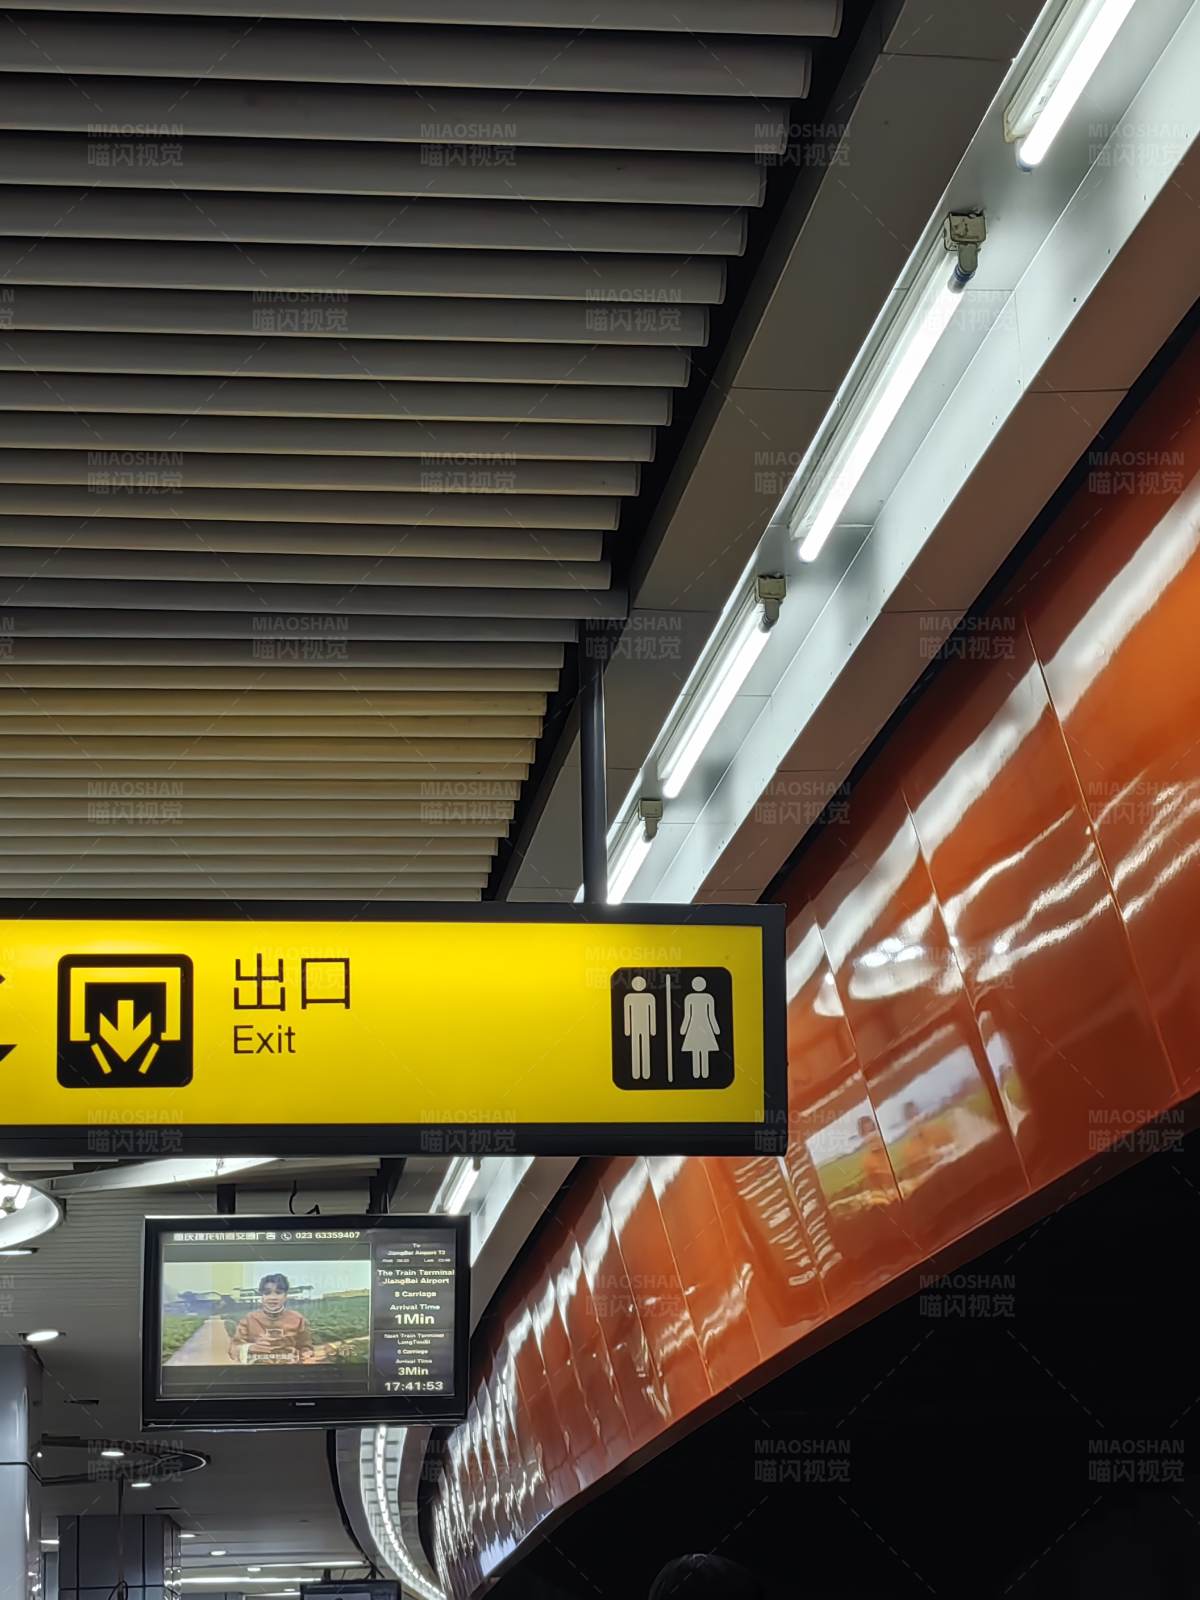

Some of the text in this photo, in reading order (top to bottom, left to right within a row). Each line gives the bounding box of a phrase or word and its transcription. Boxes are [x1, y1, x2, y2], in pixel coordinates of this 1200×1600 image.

[233, 952, 351, 1012] 出口
[233, 1025, 297, 1055] Exit
[295, 1231, 313, 1240] 023
[315, 1231, 361, 1240] 63359407
[395, 1313, 435, 1325] 1Min
[398, 1366, 429, 1376] 3Min
[384, 1381, 444, 1391] 17:41:53
